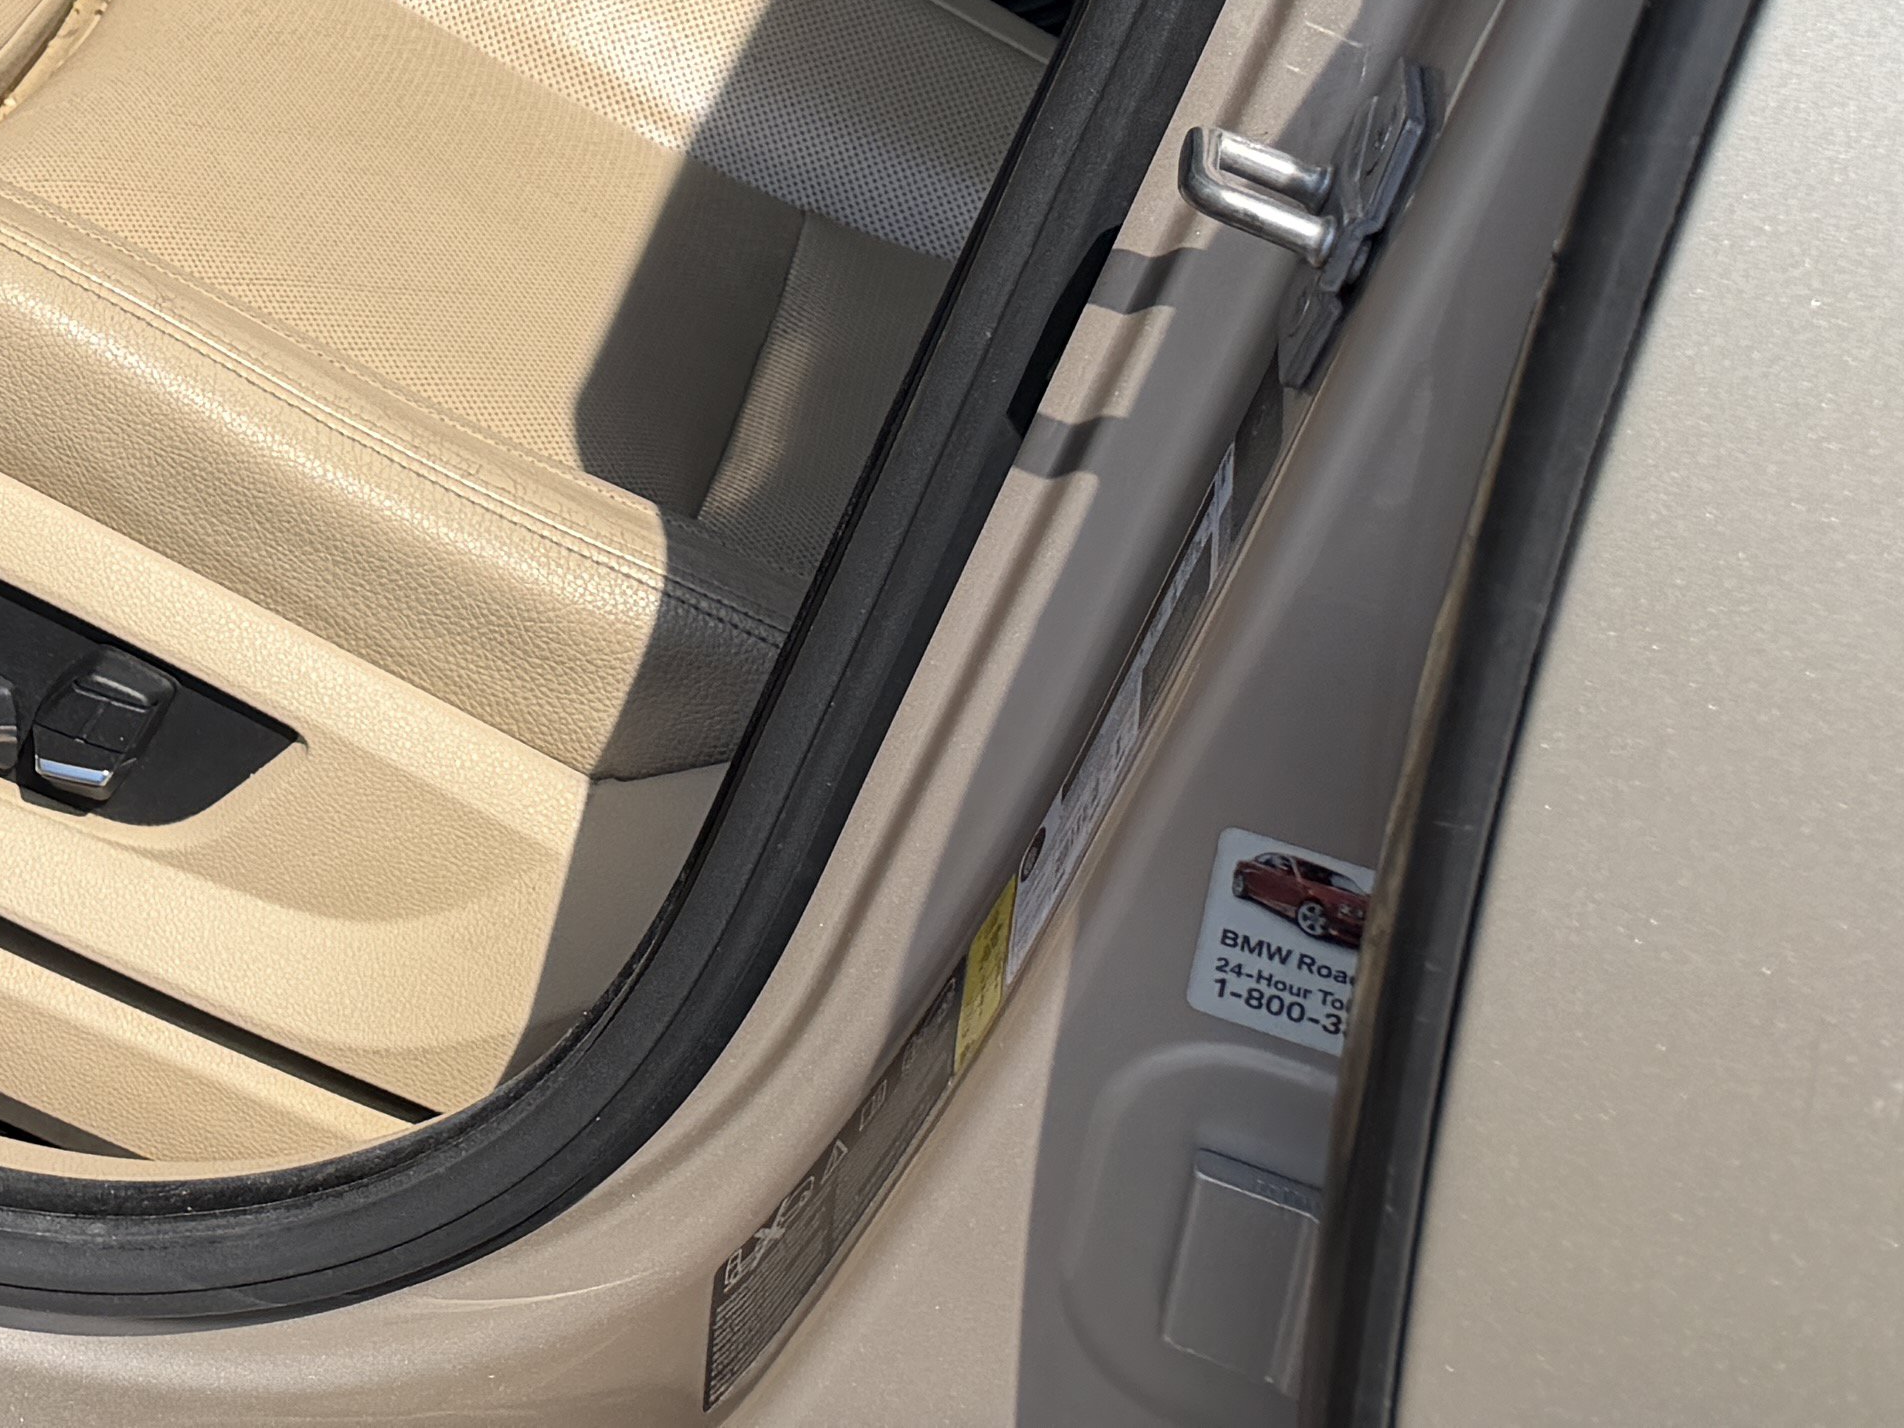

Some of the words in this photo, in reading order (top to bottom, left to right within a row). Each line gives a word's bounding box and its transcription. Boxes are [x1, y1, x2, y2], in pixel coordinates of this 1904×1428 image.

[1214, 956, 1313, 1000] 24-Hour
[1318, 988, 1351, 1014] To
[1219, 927, 1293, 965] BMW
[1297, 952, 1356, 986] Roa
[1213, 977, 1348, 1036] 1-800-3
